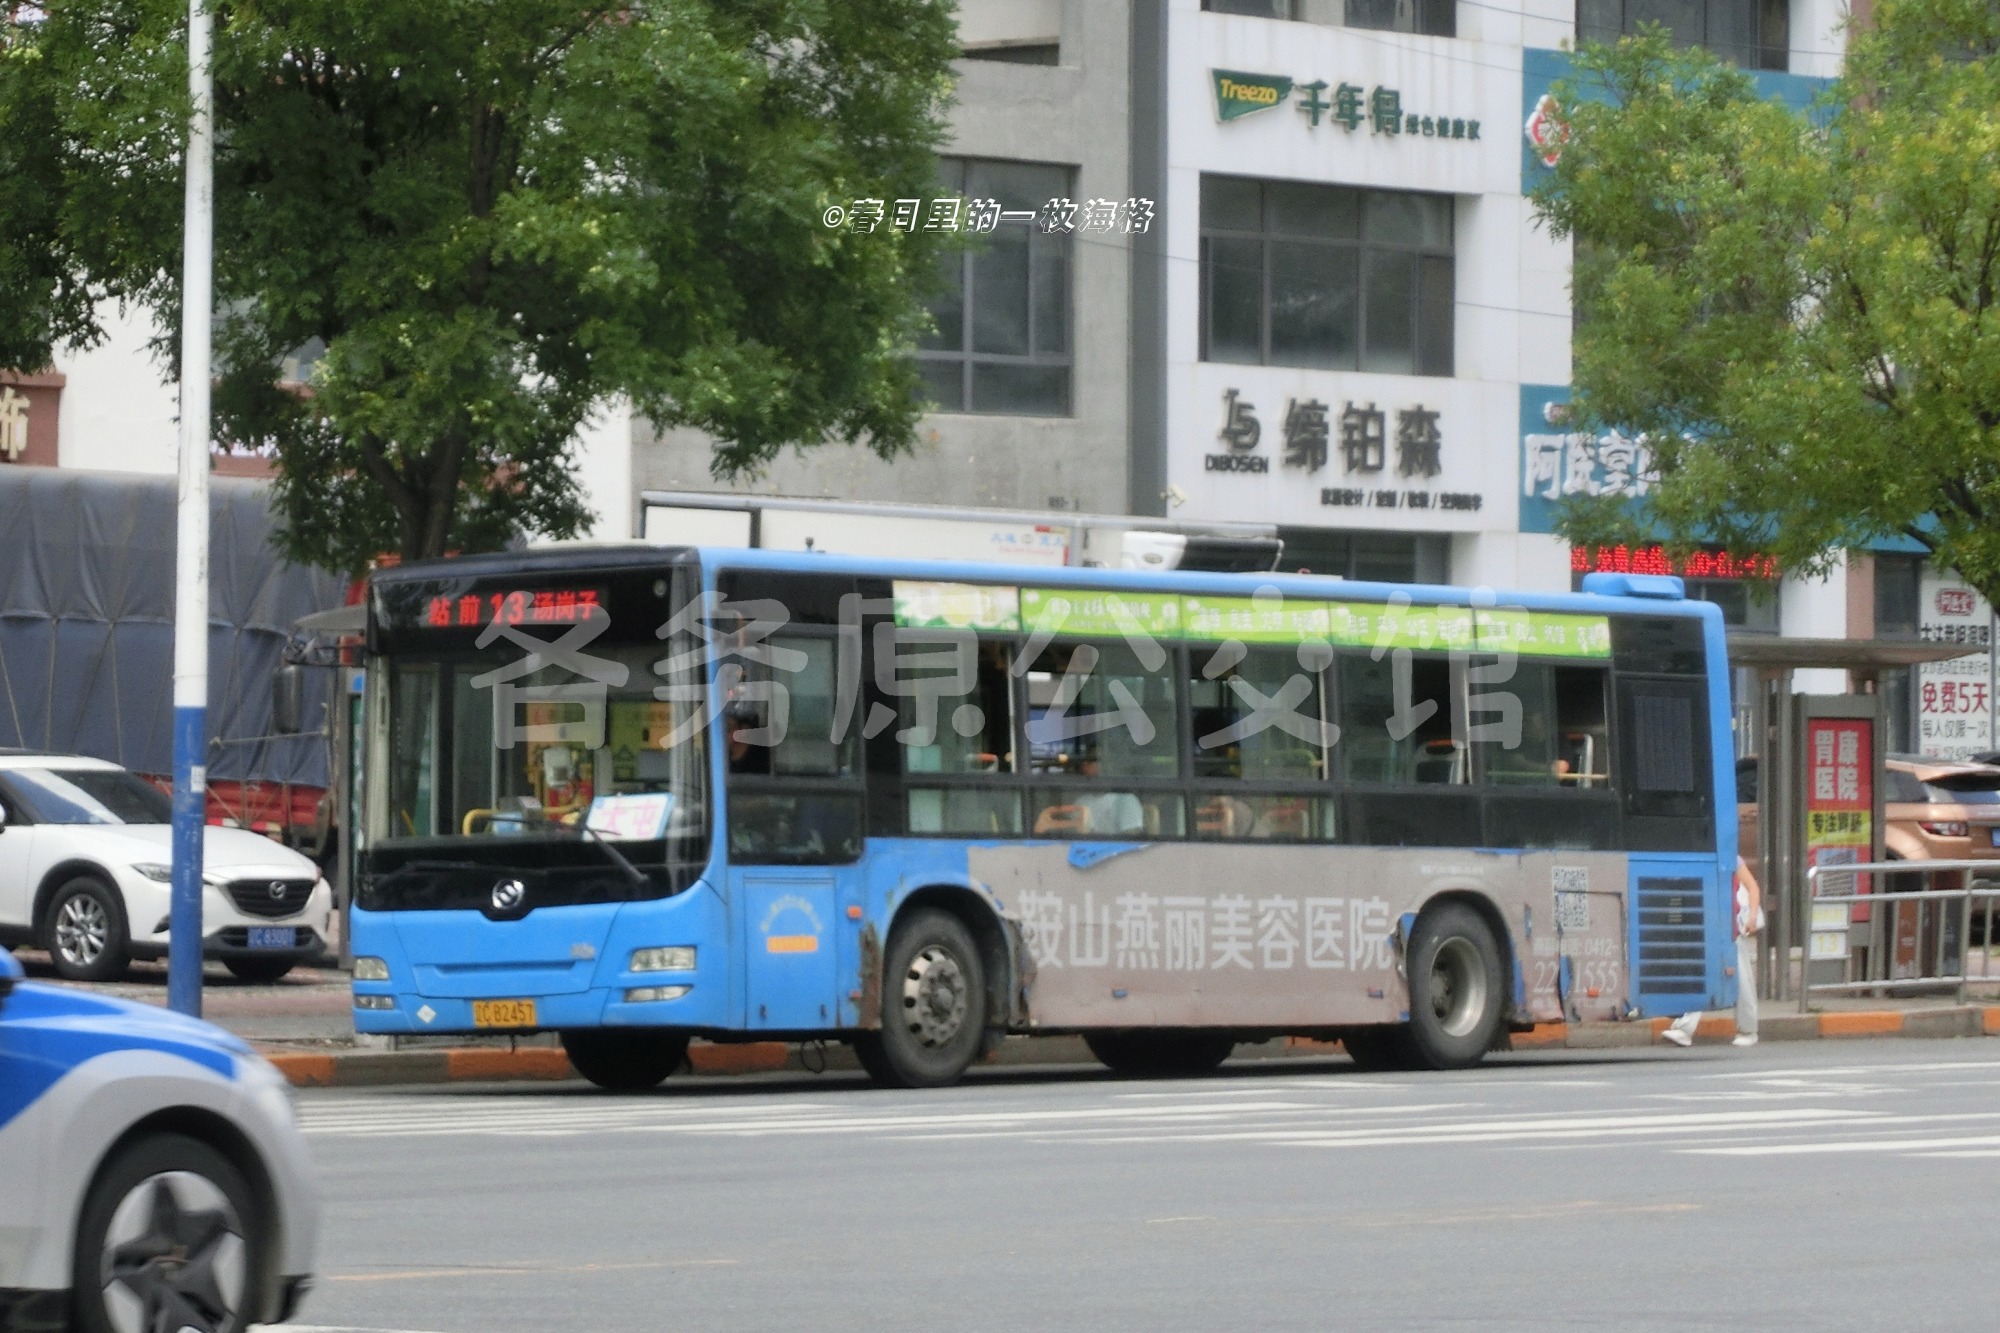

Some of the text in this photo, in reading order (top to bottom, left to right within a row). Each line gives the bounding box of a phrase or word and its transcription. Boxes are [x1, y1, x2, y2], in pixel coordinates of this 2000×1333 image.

[1220, 79, 1278, 105] Treezo
[489, 591, 525, 625] 13
[532, 590, 600, 621] 汤岗子
[1921, 681, 1989, 714] 免费5天
[1815, 766, 1858, 801] 医院
[1018, 889, 1393, 972] 鞍山燕丽美容医院
[1533, 960, 1619, 993] 221555
